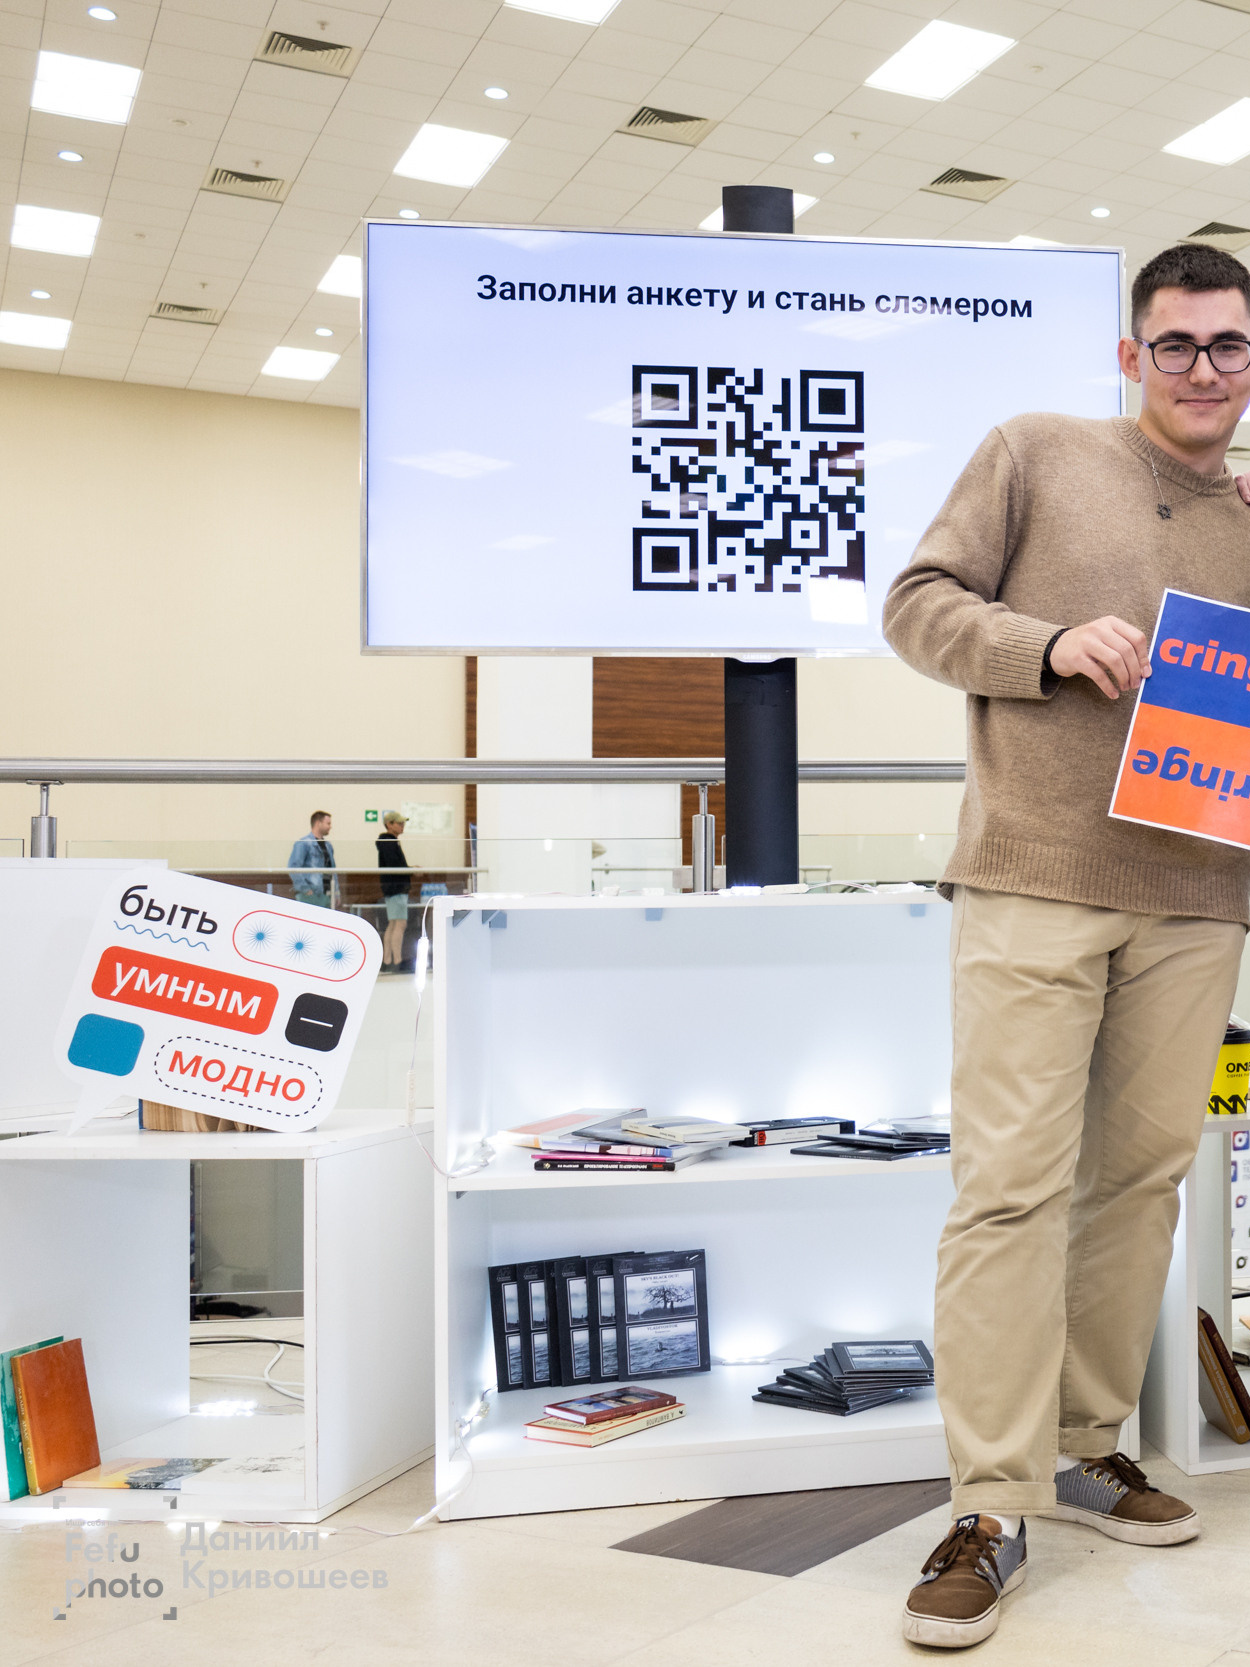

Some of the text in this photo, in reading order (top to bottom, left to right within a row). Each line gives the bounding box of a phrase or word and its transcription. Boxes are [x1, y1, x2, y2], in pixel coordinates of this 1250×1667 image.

[477, 274, 1032, 322] Заполни анкету и стань слэмером
[120, 885, 218, 934] быть
[110, 962, 262, 1020] умным
[169, 1050, 306, 1102] модно
